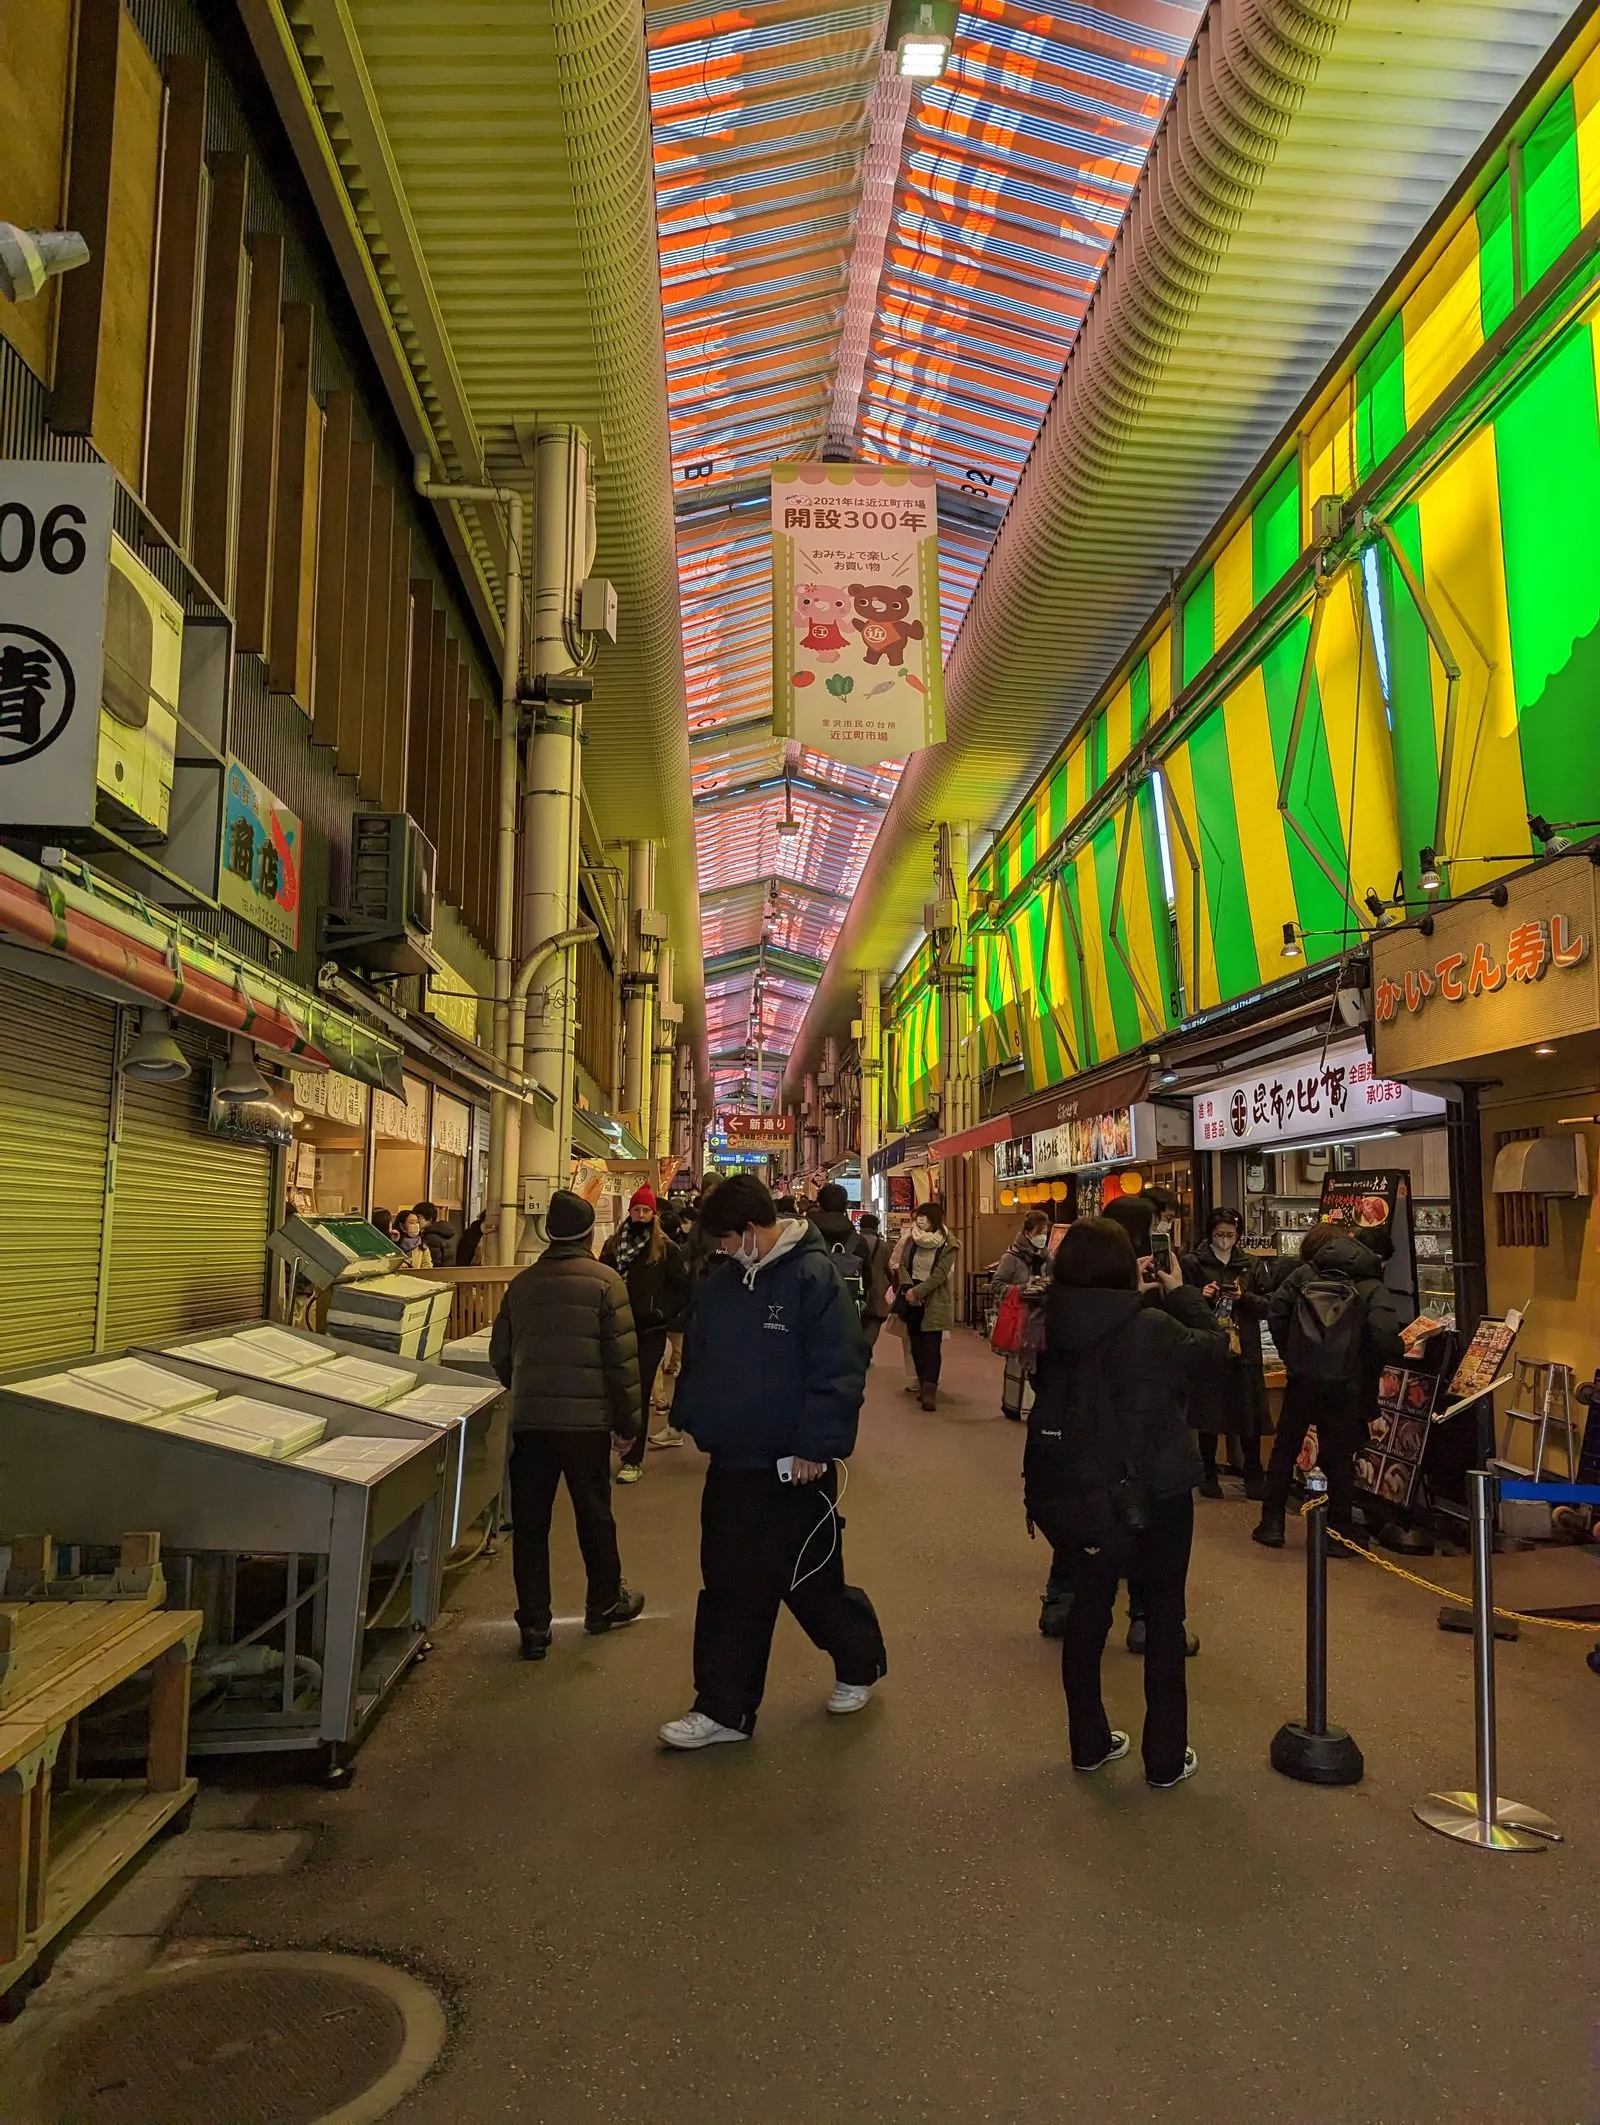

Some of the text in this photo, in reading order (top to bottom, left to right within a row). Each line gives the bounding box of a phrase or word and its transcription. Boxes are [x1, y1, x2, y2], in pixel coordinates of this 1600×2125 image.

[813, 496, 926, 509] 2021年は近江町市場
[784, 508, 927, 533] 開設300年
[0, 502, 87, 575] 06
[812, 549, 900, 562] おみちょで楽しく
[834, 561, 881, 572] お買い物
[866, 626, 885, 641] 近
[821, 718, 897, 729] 金沢市民の台所
[830, 730, 888, 742] 近江町市場
[1375, 913, 1588, 1023] かいてん寿し
[1170, 991, 1179, 1018] 5
[1013, 1029, 1020, 1047] 6
[1366, 1080, 1402, 1104] 承ります
[749, 1118, 786, 1131] 新通り
